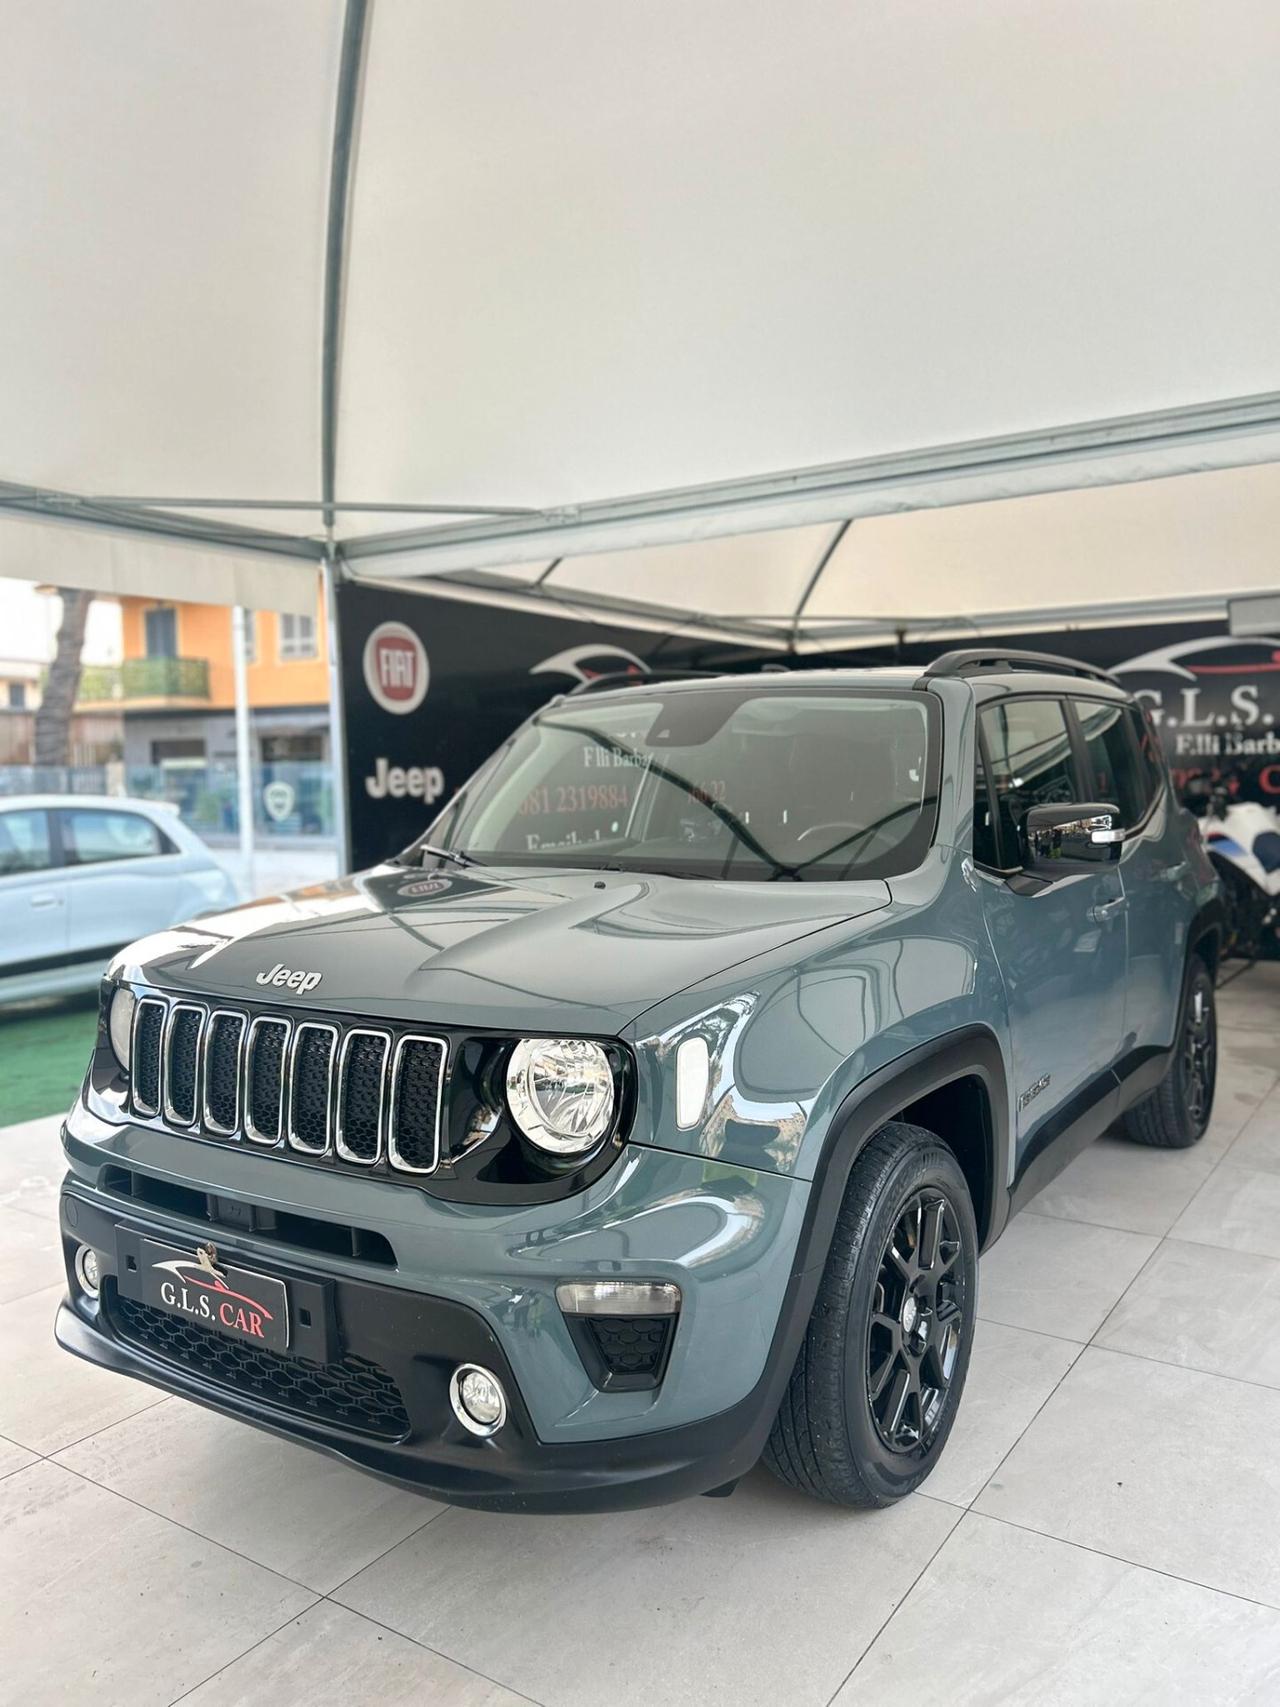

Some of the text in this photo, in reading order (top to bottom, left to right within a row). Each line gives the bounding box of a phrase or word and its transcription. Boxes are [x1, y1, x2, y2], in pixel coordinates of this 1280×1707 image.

[380, 648, 414, 688] FIAT
[365, 758, 444, 804] Jeep
[557, 784, 629, 812] 2319884
[256, 964, 322, 995] Jeep
[161, 1282, 265, 1338] G.L.S. CAR
